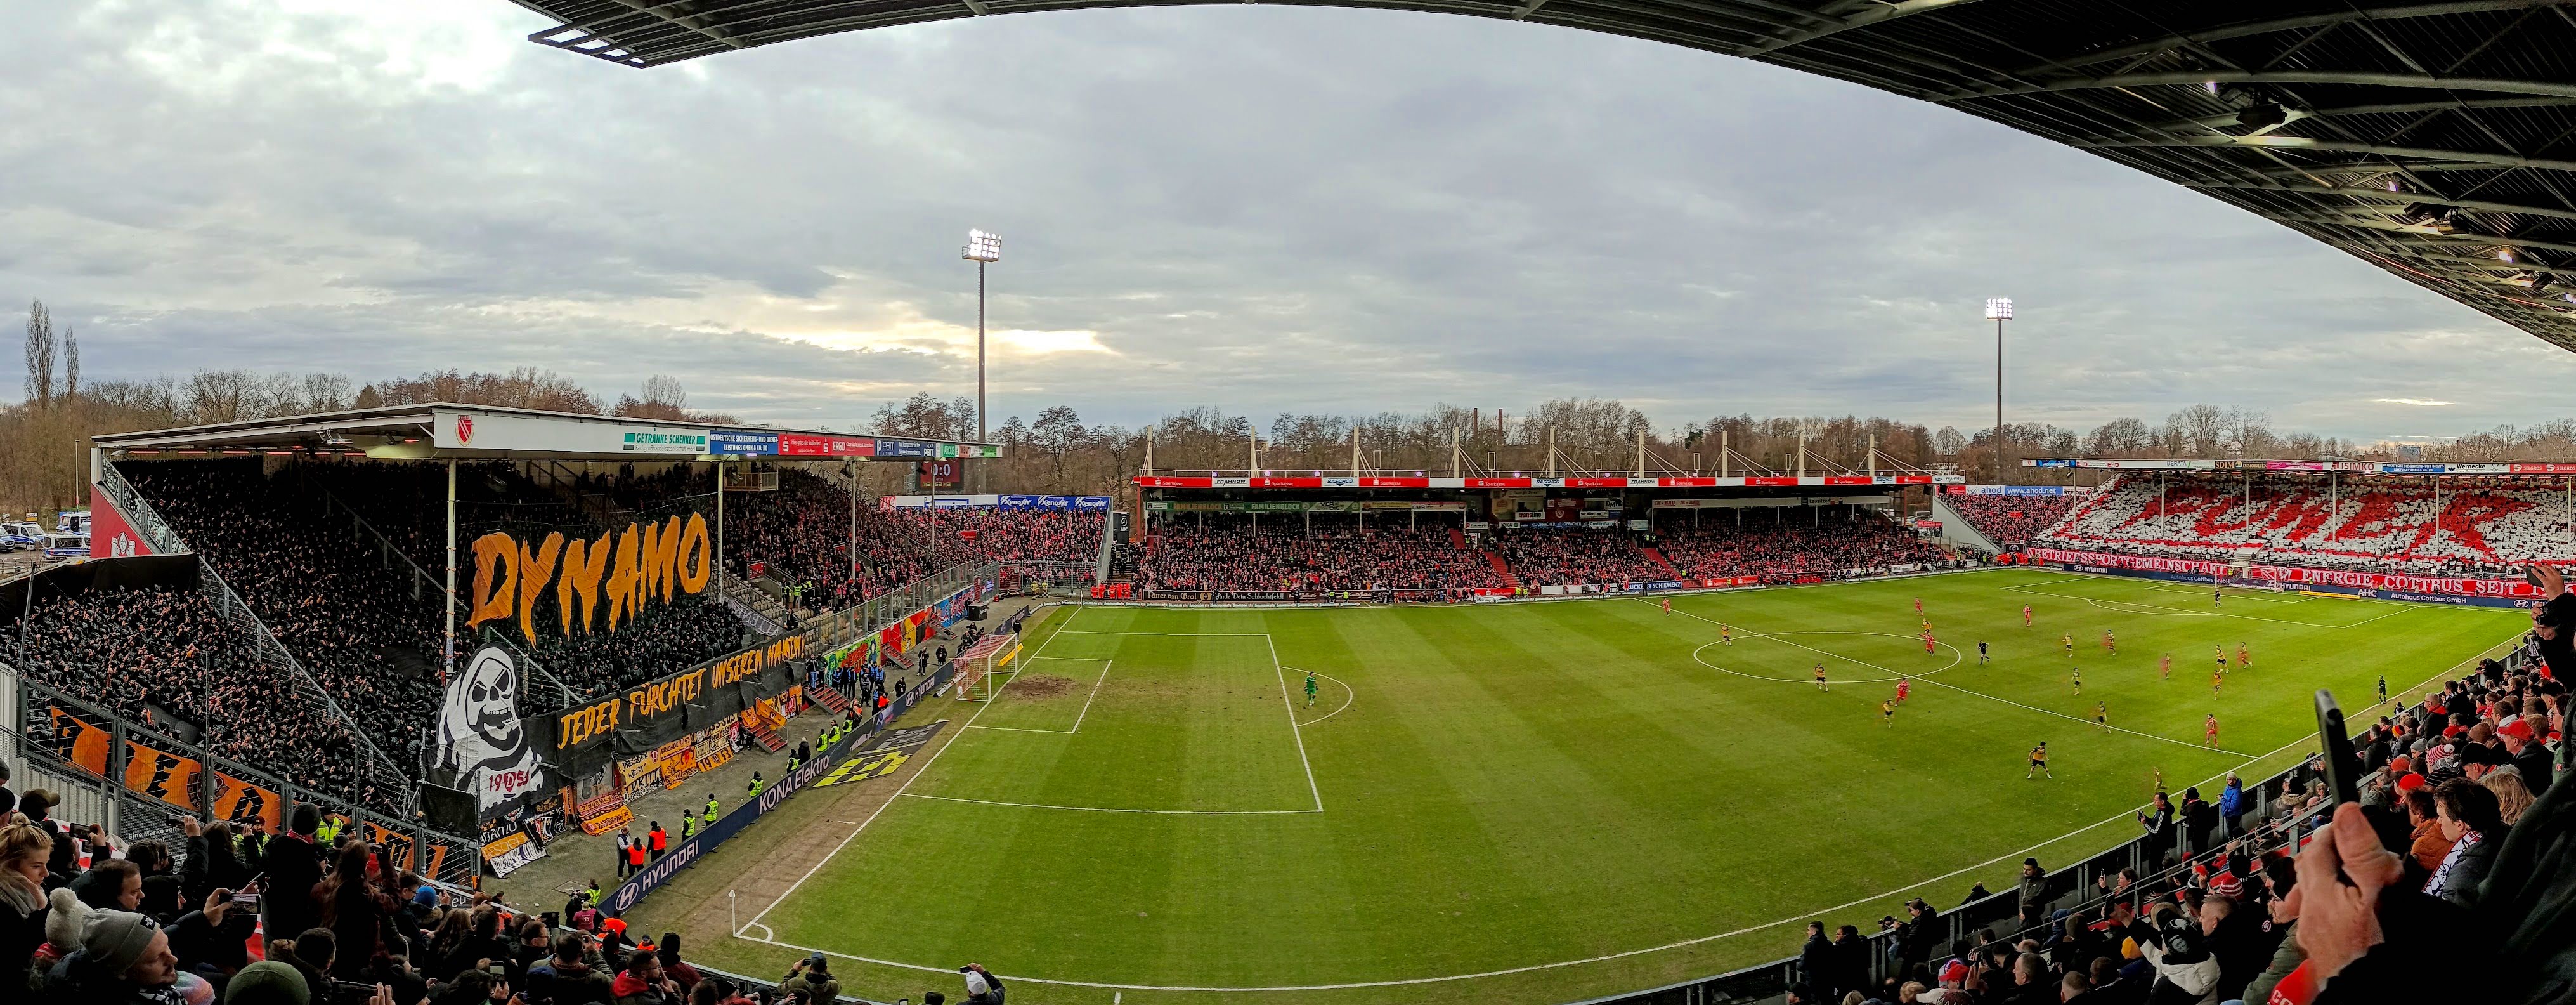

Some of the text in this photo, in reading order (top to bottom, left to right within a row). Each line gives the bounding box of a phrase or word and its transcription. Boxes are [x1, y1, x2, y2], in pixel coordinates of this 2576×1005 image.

[669, 434, 695, 444] SCHENKER
[833, 441, 845, 452] ERGO
[931, 464, 951, 476] 0:0
[2341, 462, 2374, 470] ISIMKO
[1000, 496, 1032, 506] Xenofit
[1038, 496, 1069, 507] Xenofit
[1076, 497, 1107, 507] Xenofit
[465, 511, 711, 652] DYNAMO
[1653, 581, 1681, 589] SCHIEMENZ
[2281, 582, 2311, 591] HYUNDAI
[2358, 589, 2377, 598] AHC
[2476, 581, 2518, 596] SEIT
[558, 697, 620, 750] JEDER
[630, 668, 707, 724] FÜRCHTET
[712, 647, 764, 690] UNSEREN
[767, 633, 805, 669] NAMEN!
[661, 742, 679, 754] BRIGADE
[622, 751, 648, 771] DRESDEN
[701, 759, 712, 772] 19
[722, 747, 732, 761] 53
[489, 773, 502, 792] 19
[760, 754, 829, 815] KONA Elektro
[580, 794, 614, 812] AKTIVIST
[144, 828, 164, 837] Marke
[642, 839, 699, 892] HYUNDAI
